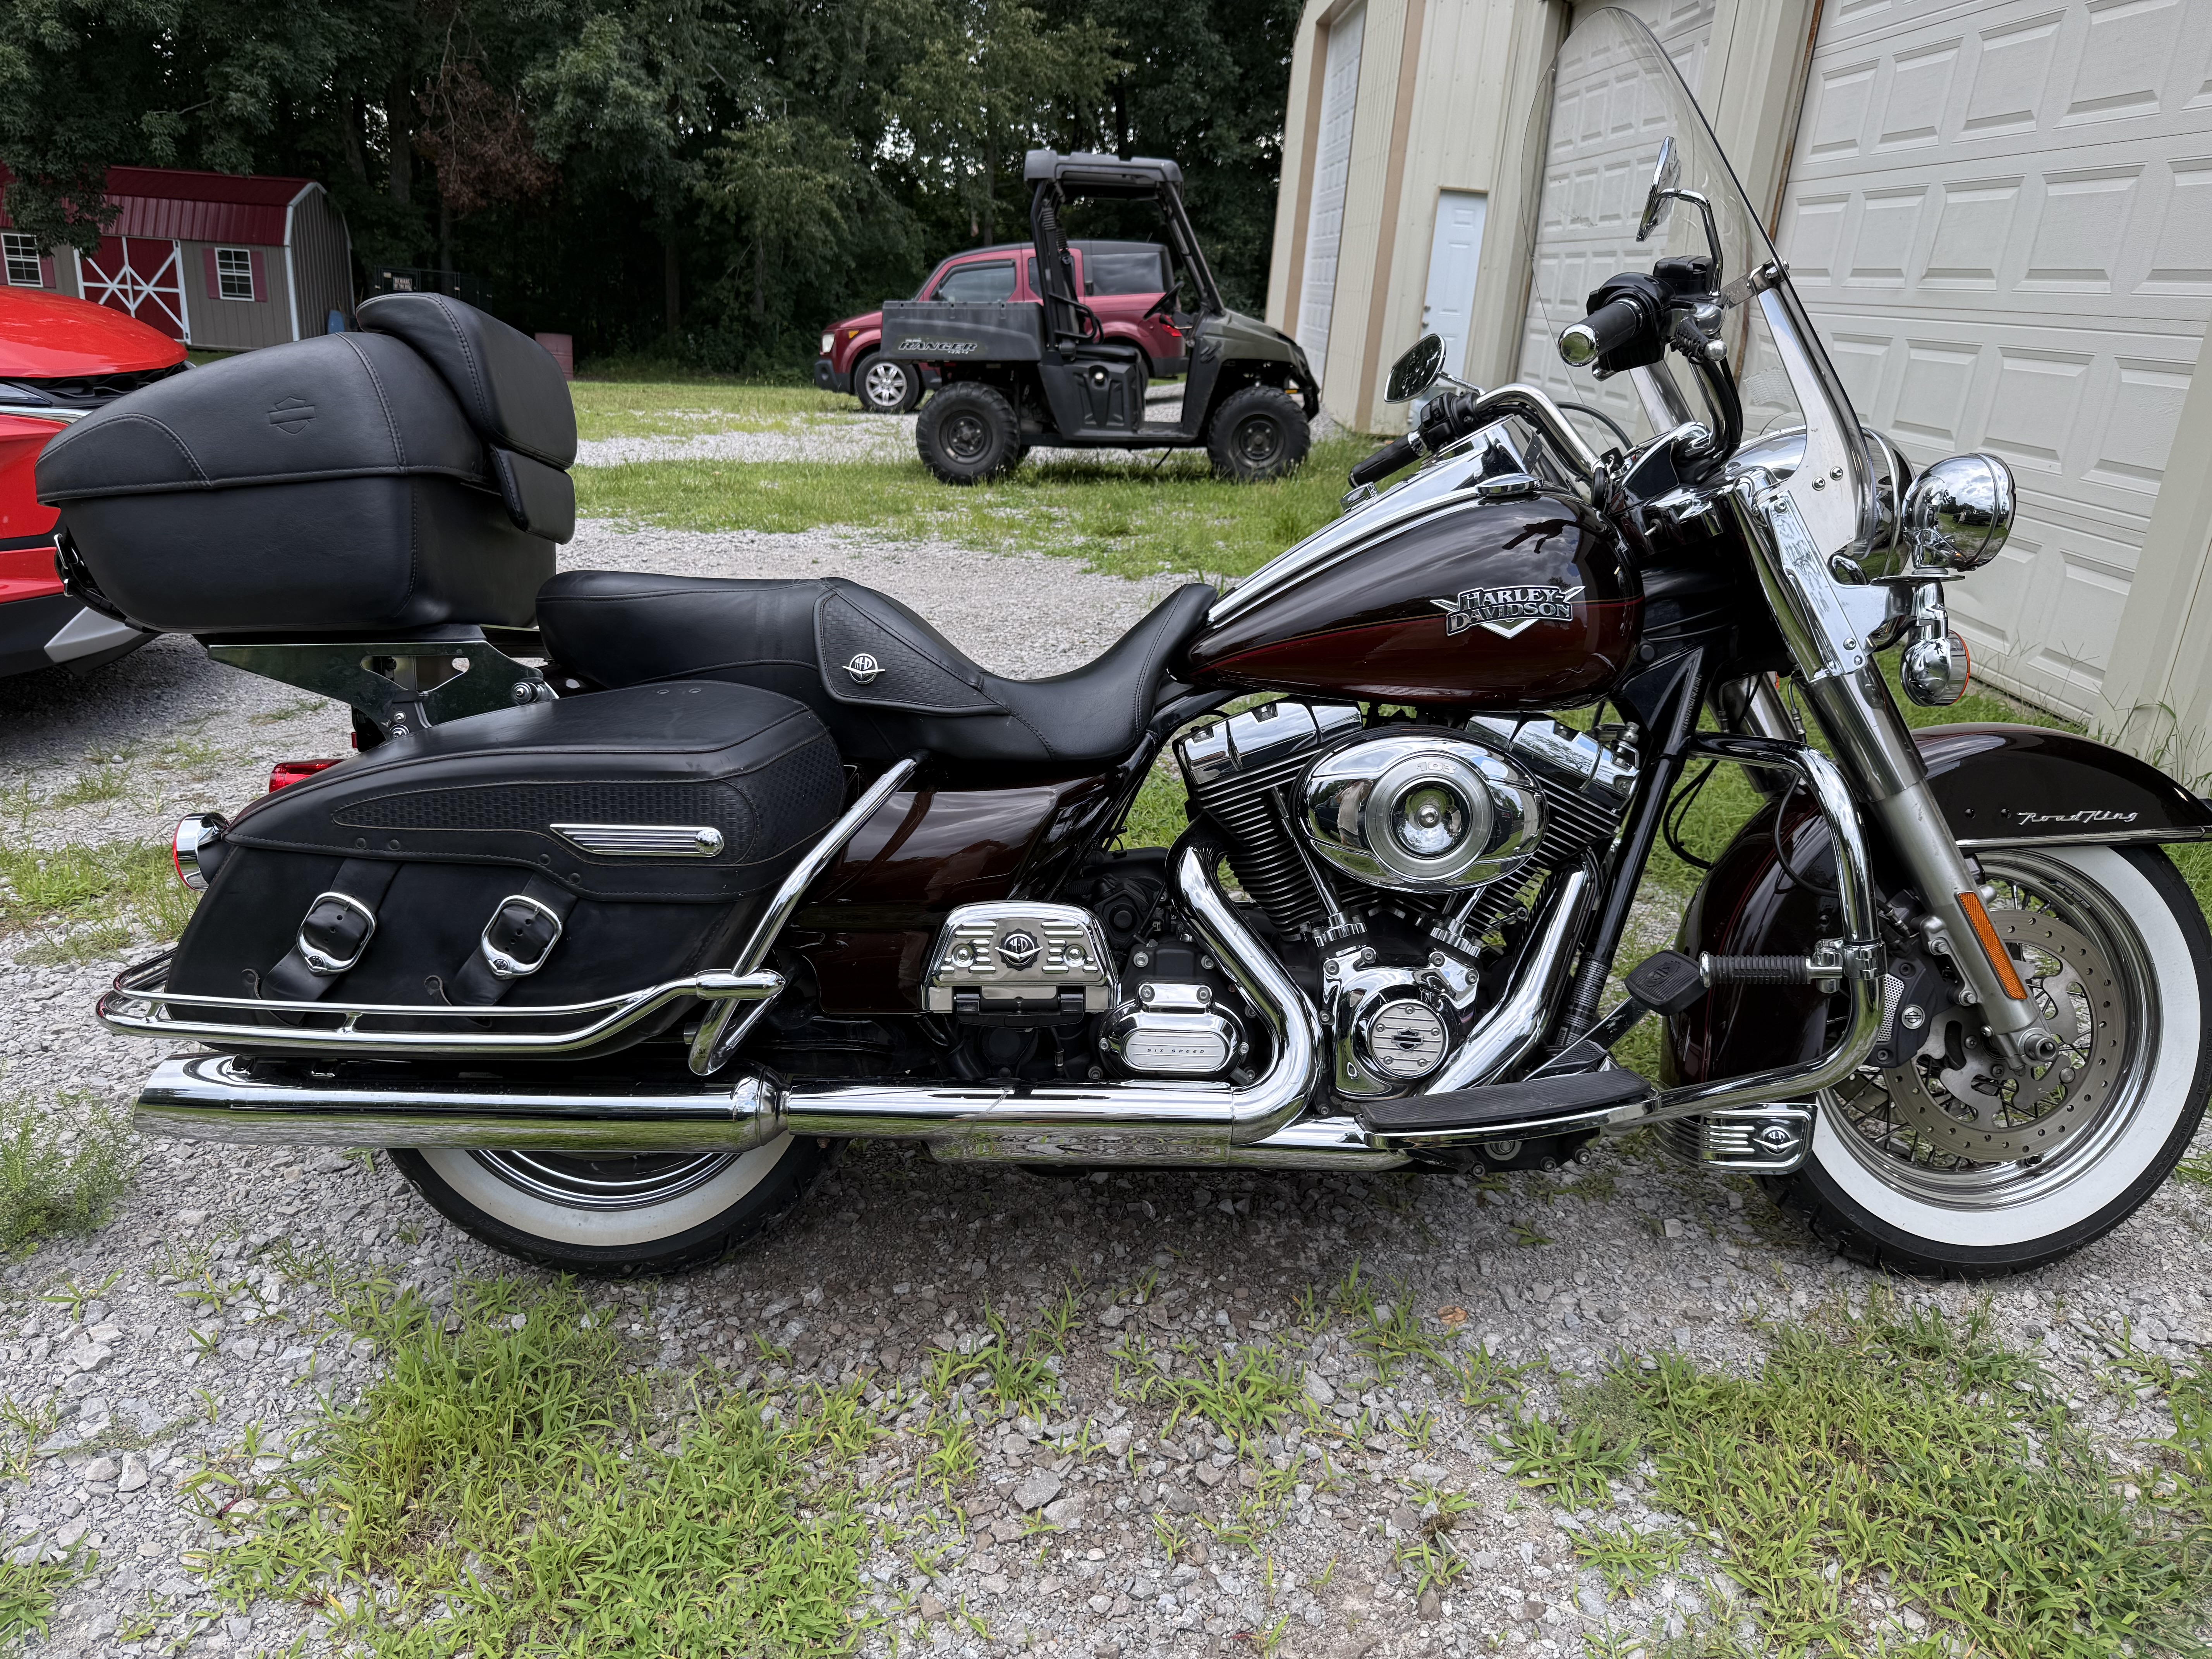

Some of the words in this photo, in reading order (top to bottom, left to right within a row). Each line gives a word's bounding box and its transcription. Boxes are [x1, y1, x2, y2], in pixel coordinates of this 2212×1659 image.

[898, 342, 978, 351] RANGER
[1450, 603, 1570, 632] DAVIDSON
[1417, 761, 1458, 774] 103
